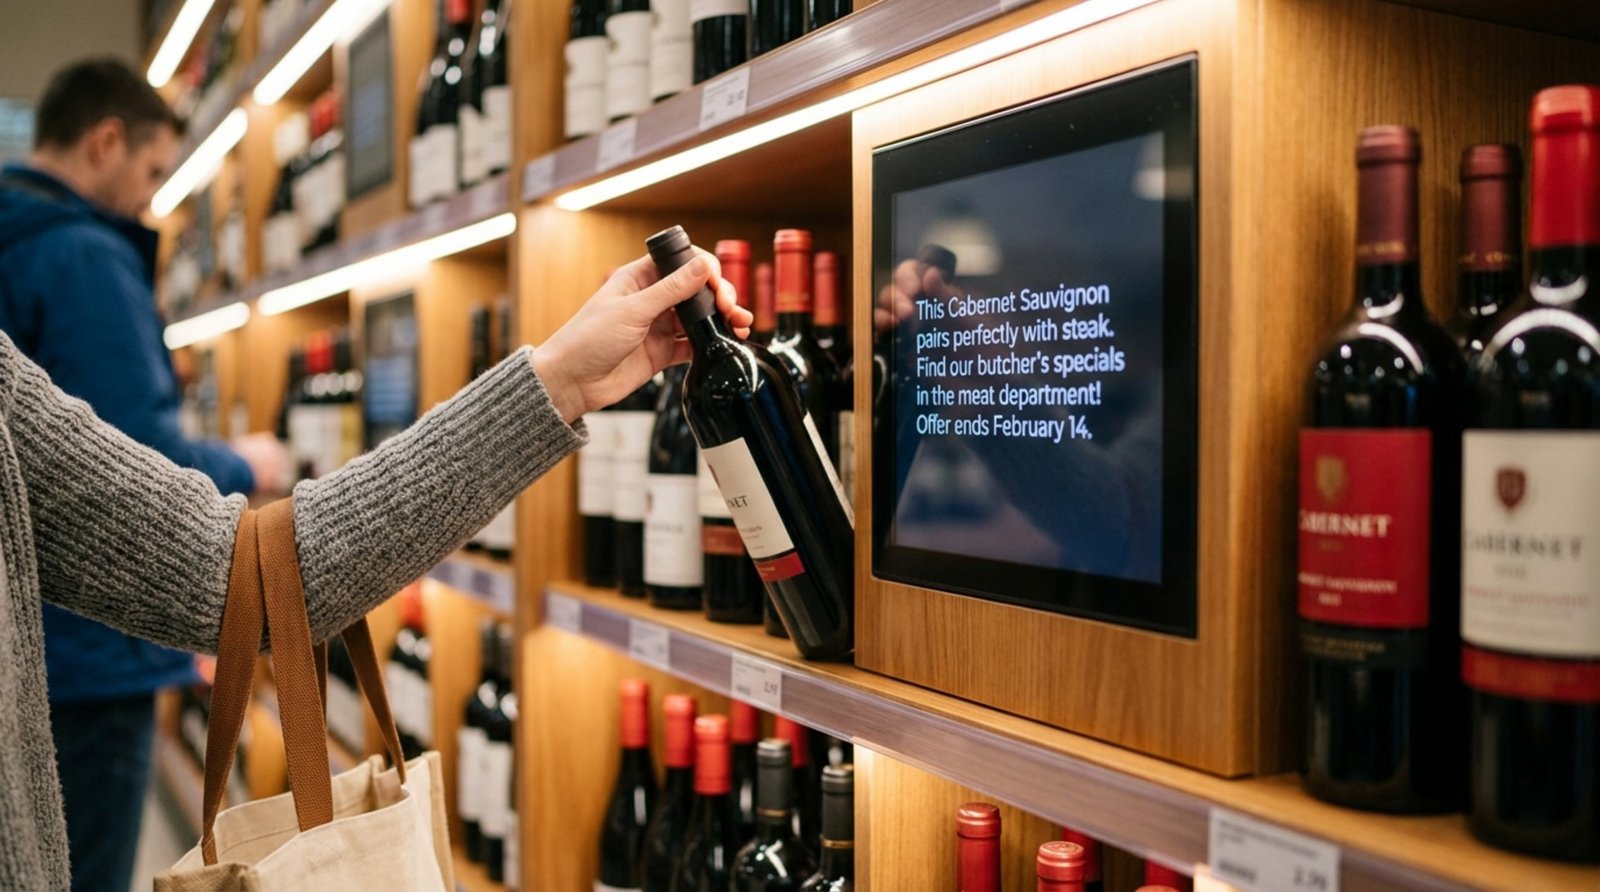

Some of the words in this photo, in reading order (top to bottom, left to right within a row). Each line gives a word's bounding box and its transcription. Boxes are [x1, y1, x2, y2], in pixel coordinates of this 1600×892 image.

[916, 299, 945, 320] This
[948, 291, 1016, 318] Cabernet
[1020, 283, 1110, 312] Sauvignon
[916, 328, 950, 354] pairs
[953, 321, 1019, 352] perfectly
[1022, 318, 1058, 342] with
[1062, 313, 1114, 340] steak.
[916, 355, 946, 378] Find
[950, 359, 973, 377] our
[977, 350, 1050, 376] butcher's
[1053, 346, 1125, 378] specials
[916, 385, 929, 405] in
[931, 385, 955, 406] the
[958, 387, 995, 406] meat
[999, 381, 1101, 410] department!
[916, 413, 951, 436] Offer
[954, 414, 989, 436] ends
[993, 414, 1065, 443] February
[1068, 415, 1093, 440] 14.
